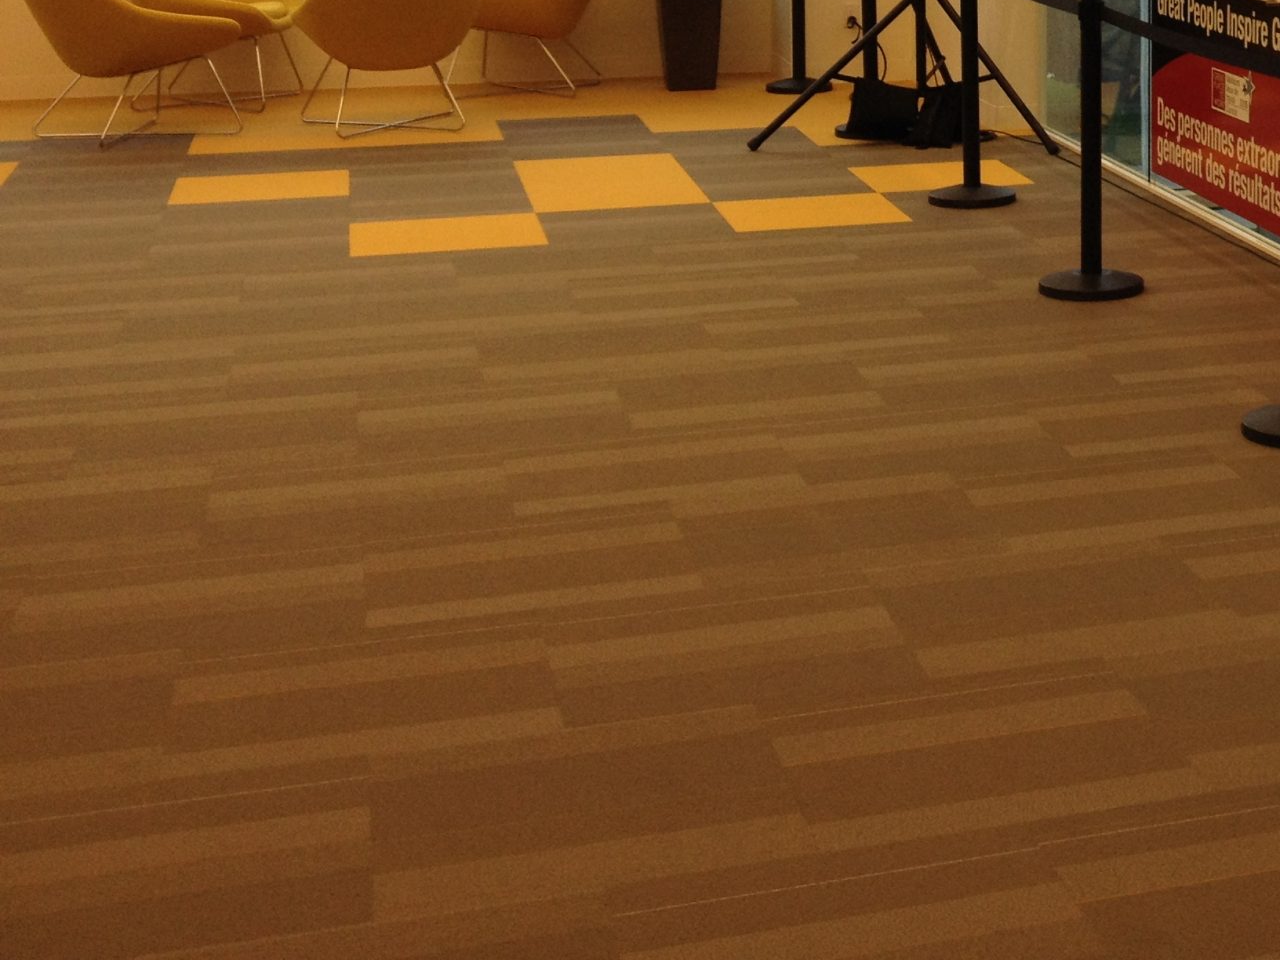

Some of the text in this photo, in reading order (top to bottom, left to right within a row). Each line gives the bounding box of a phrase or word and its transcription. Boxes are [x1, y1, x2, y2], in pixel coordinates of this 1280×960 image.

[1226, 3, 1269, 49] Inspire
[1157, 96, 1176, 132] Des
[1177, 108, 1235, 158] personnes
[1205, 153, 1226, 191] des
